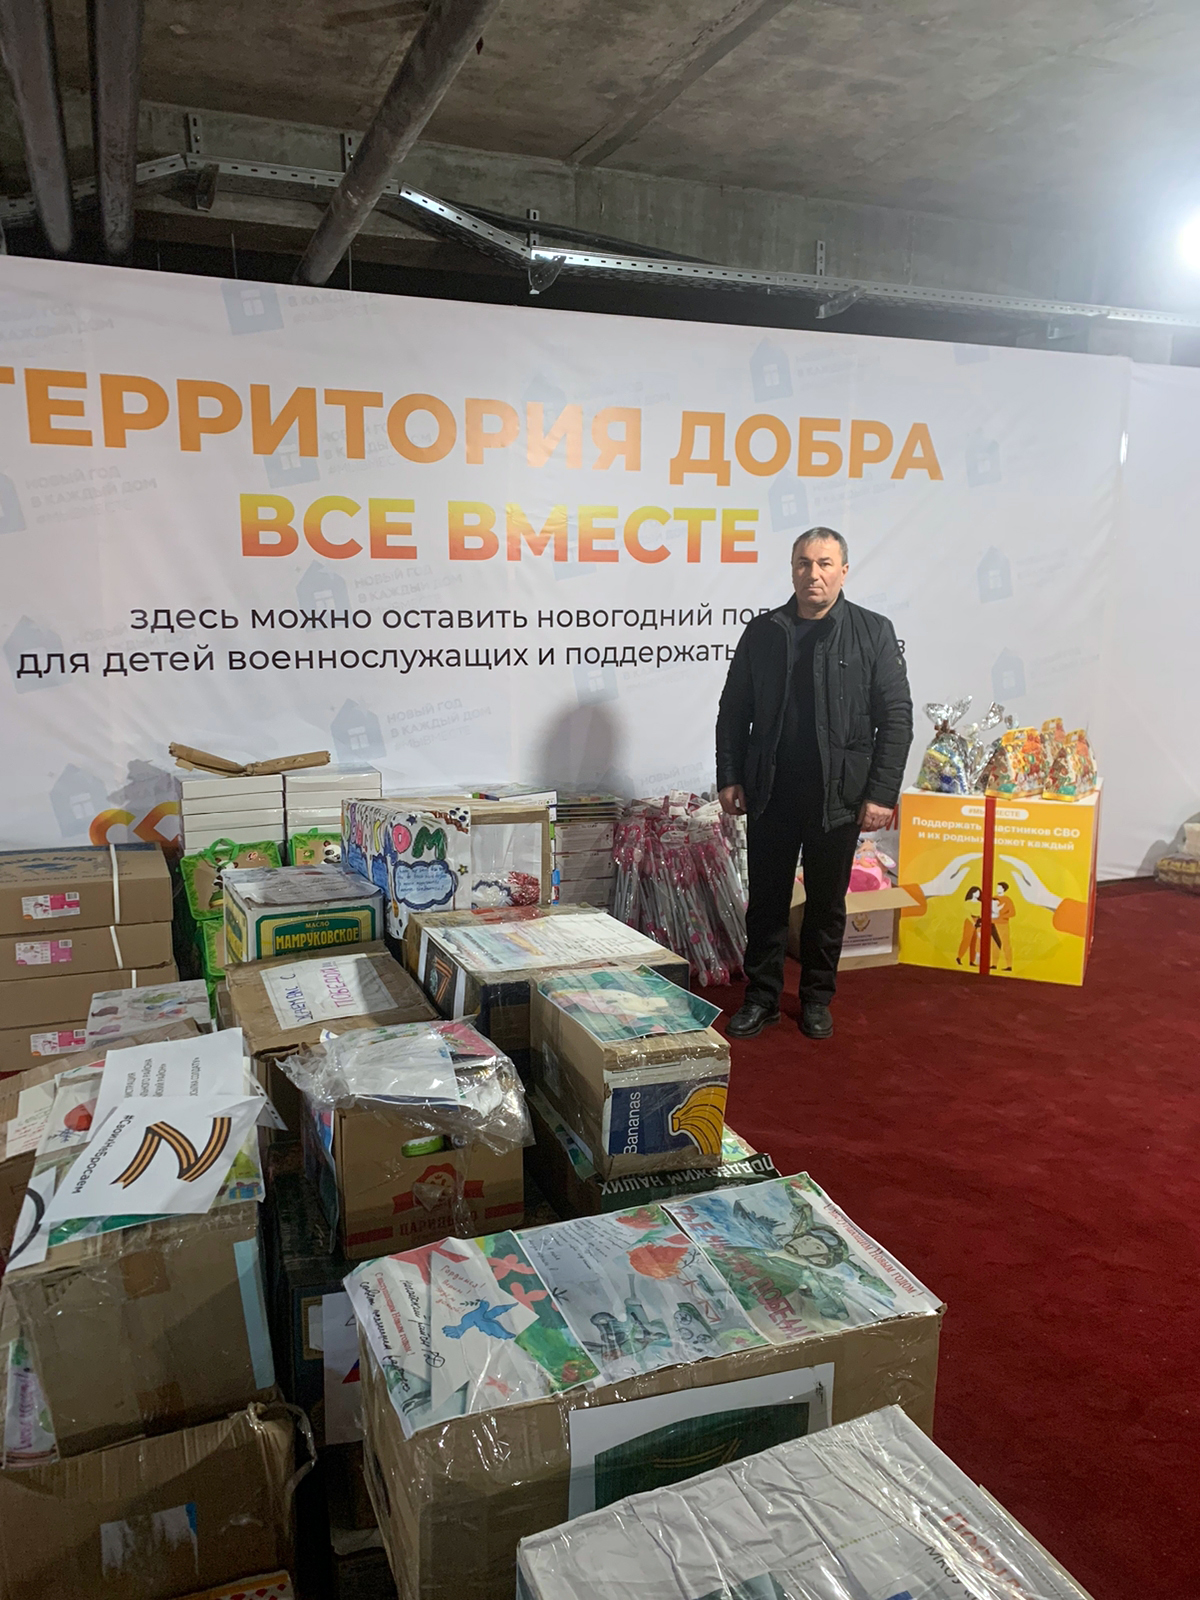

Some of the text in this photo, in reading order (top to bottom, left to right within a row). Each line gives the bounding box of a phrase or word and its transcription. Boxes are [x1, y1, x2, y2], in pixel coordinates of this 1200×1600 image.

[669, 410, 944, 487] ДОБРА
[239, 493, 418, 560] ВСЕ
[447, 499, 759, 565] ВМЕСТЕ
[130, 608, 240, 634] здесь
[251, 607, 372, 630] можно
[382, 606, 528, 630] оставить
[537, 602, 713, 631] новогодний
[16, 643, 737, 678] для детей военнослужащих и поддержать
[387, 698, 463, 724] НОВЫЙ ГОД
[401, 713, 459, 736] КАЖДЫЙ
[463, 706, 491, 722] ДОМ
[912, 816, 1081, 839] Поддержать астников СВО
[918, 831, 1075, 851] и их родных ожет каждый
[305, 920, 330, 929] МАСЛО
[275, 927, 359, 950] МАМРУКОВСКОЕ
[624, 1092, 641, 1154] Bananas
[599, 1176, 664, 1196] НАШИХ
[869, 1247, 896, 1273] Новым
